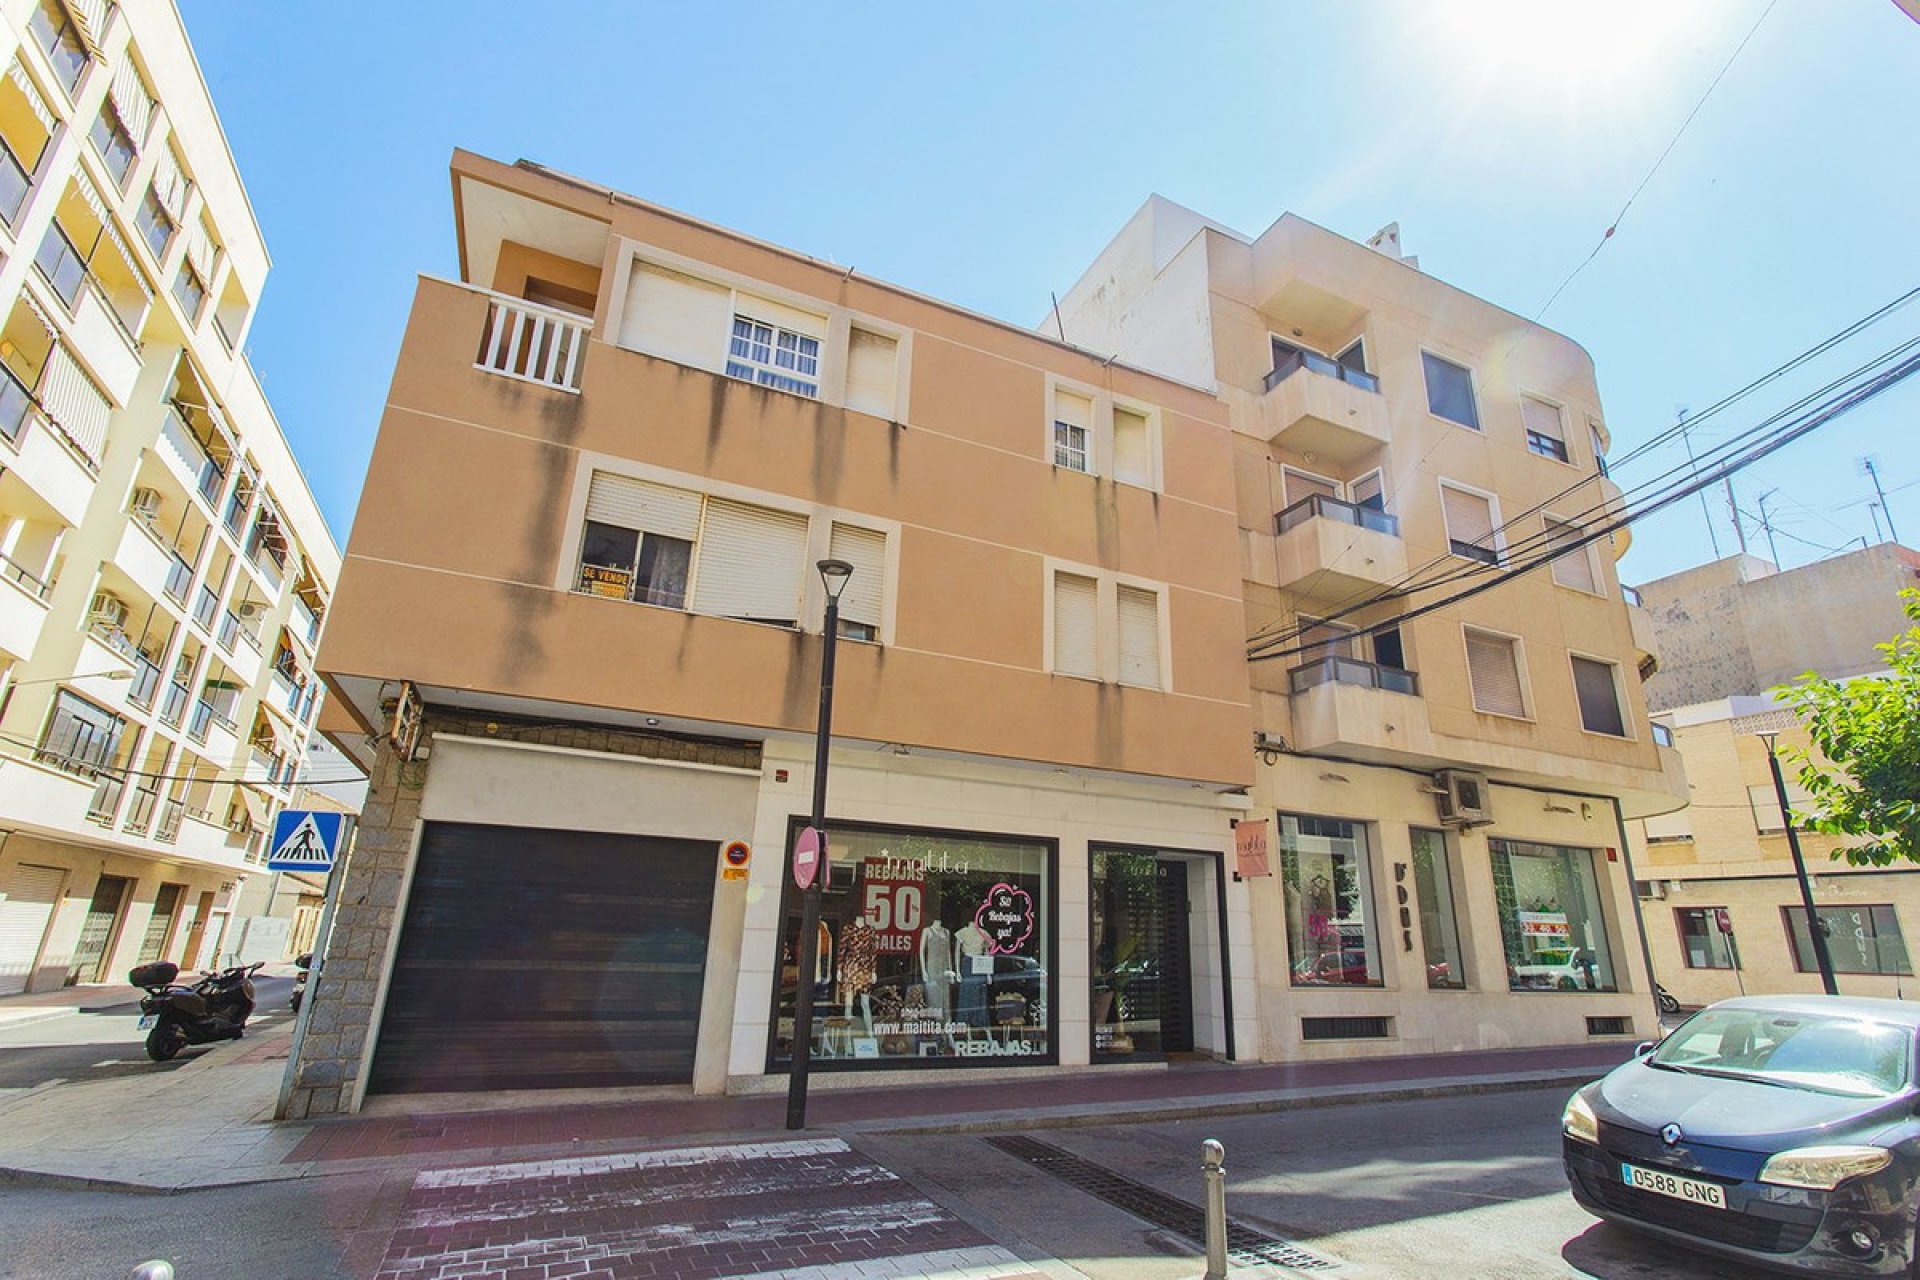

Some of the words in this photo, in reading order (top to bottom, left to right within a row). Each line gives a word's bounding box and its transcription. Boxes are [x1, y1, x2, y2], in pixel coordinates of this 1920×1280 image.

[584, 567, 595, 578] SE
[599, 570, 628, 585] VENDE
[865, 863, 924, 880] REBAJAS
[865, 884, 921, 932] 50
[954, 1040, 1032, 1056] REBAJAS
[1634, 1169, 1677, 1194] 0588
[1682, 1181, 1719, 1204] GNG
